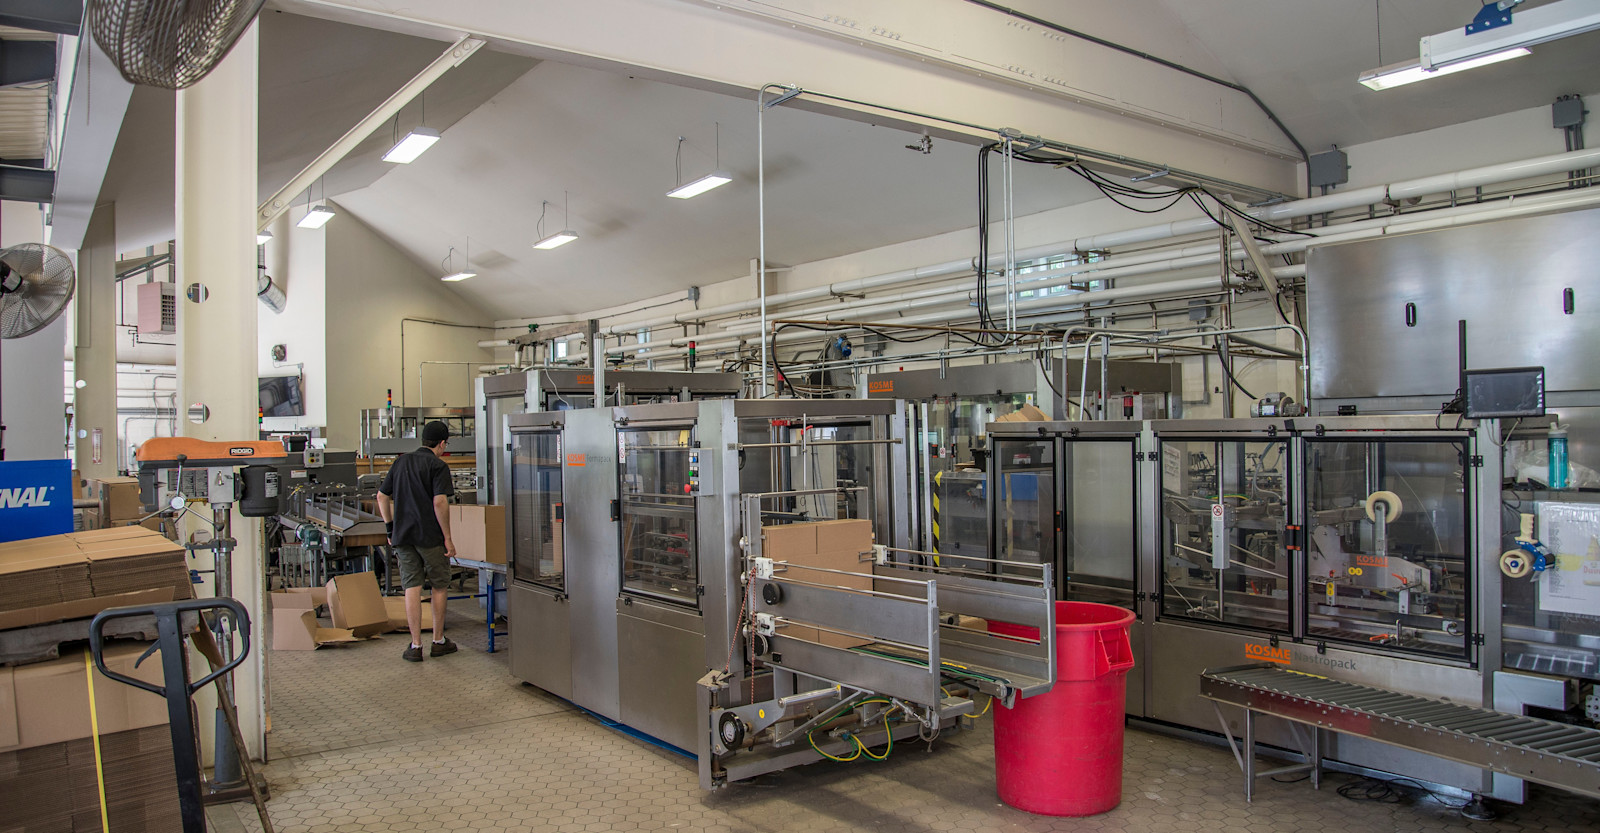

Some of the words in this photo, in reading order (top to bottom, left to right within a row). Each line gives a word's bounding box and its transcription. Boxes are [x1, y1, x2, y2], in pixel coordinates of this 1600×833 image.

[869, 380, 894, 389] KOSME
[567, 453, 586, 463] KOSME
[0, 486, 51, 509] NAL
[1245, 643, 1291, 660] KOSME
[1295, 652, 1357, 670] Nastropack
